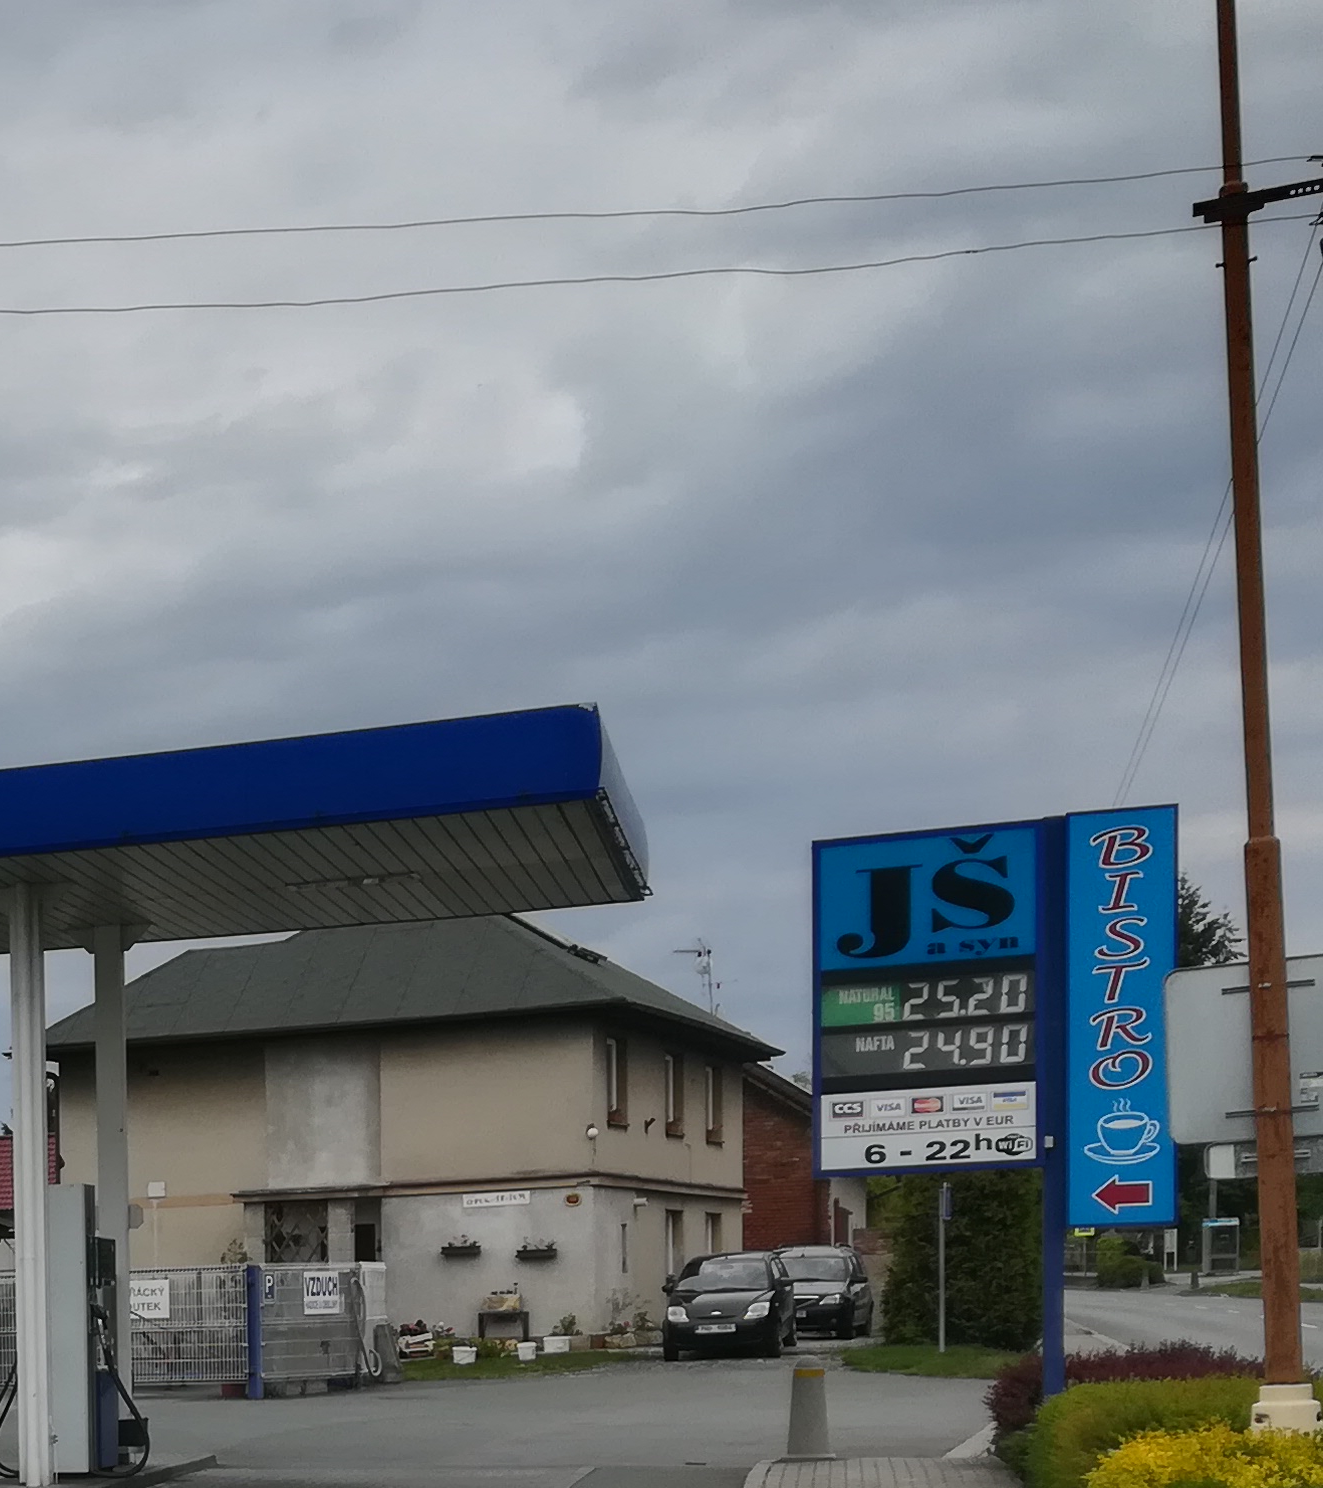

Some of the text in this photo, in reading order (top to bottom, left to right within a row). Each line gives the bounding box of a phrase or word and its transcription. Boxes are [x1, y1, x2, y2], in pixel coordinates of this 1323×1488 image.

[837, 834, 1015, 958] JŠ
[959, 936, 1019, 955] syn
[1089, 825, 1153, 1090] BISTRO
[839, 974, 1028, 1020] NATURAL 25.20
[873, 1002, 895, 1022] 95
[855, 1024, 1028, 1069] NAFTA 24.90
[834, 1103, 862, 1114] CCS
[876, 1103, 902, 1112] VISA
[958, 1096, 983, 1105] VISA
[919, 1117, 970, 1130] PLATBY
[973, 1117, 983, 1127] V
[986, 1115, 1014, 1126] EUR
[864, 1144, 886, 1164] 6
[265, 1275, 273, 1293] P
[304, 1276, 339, 1296] VZDUCH
